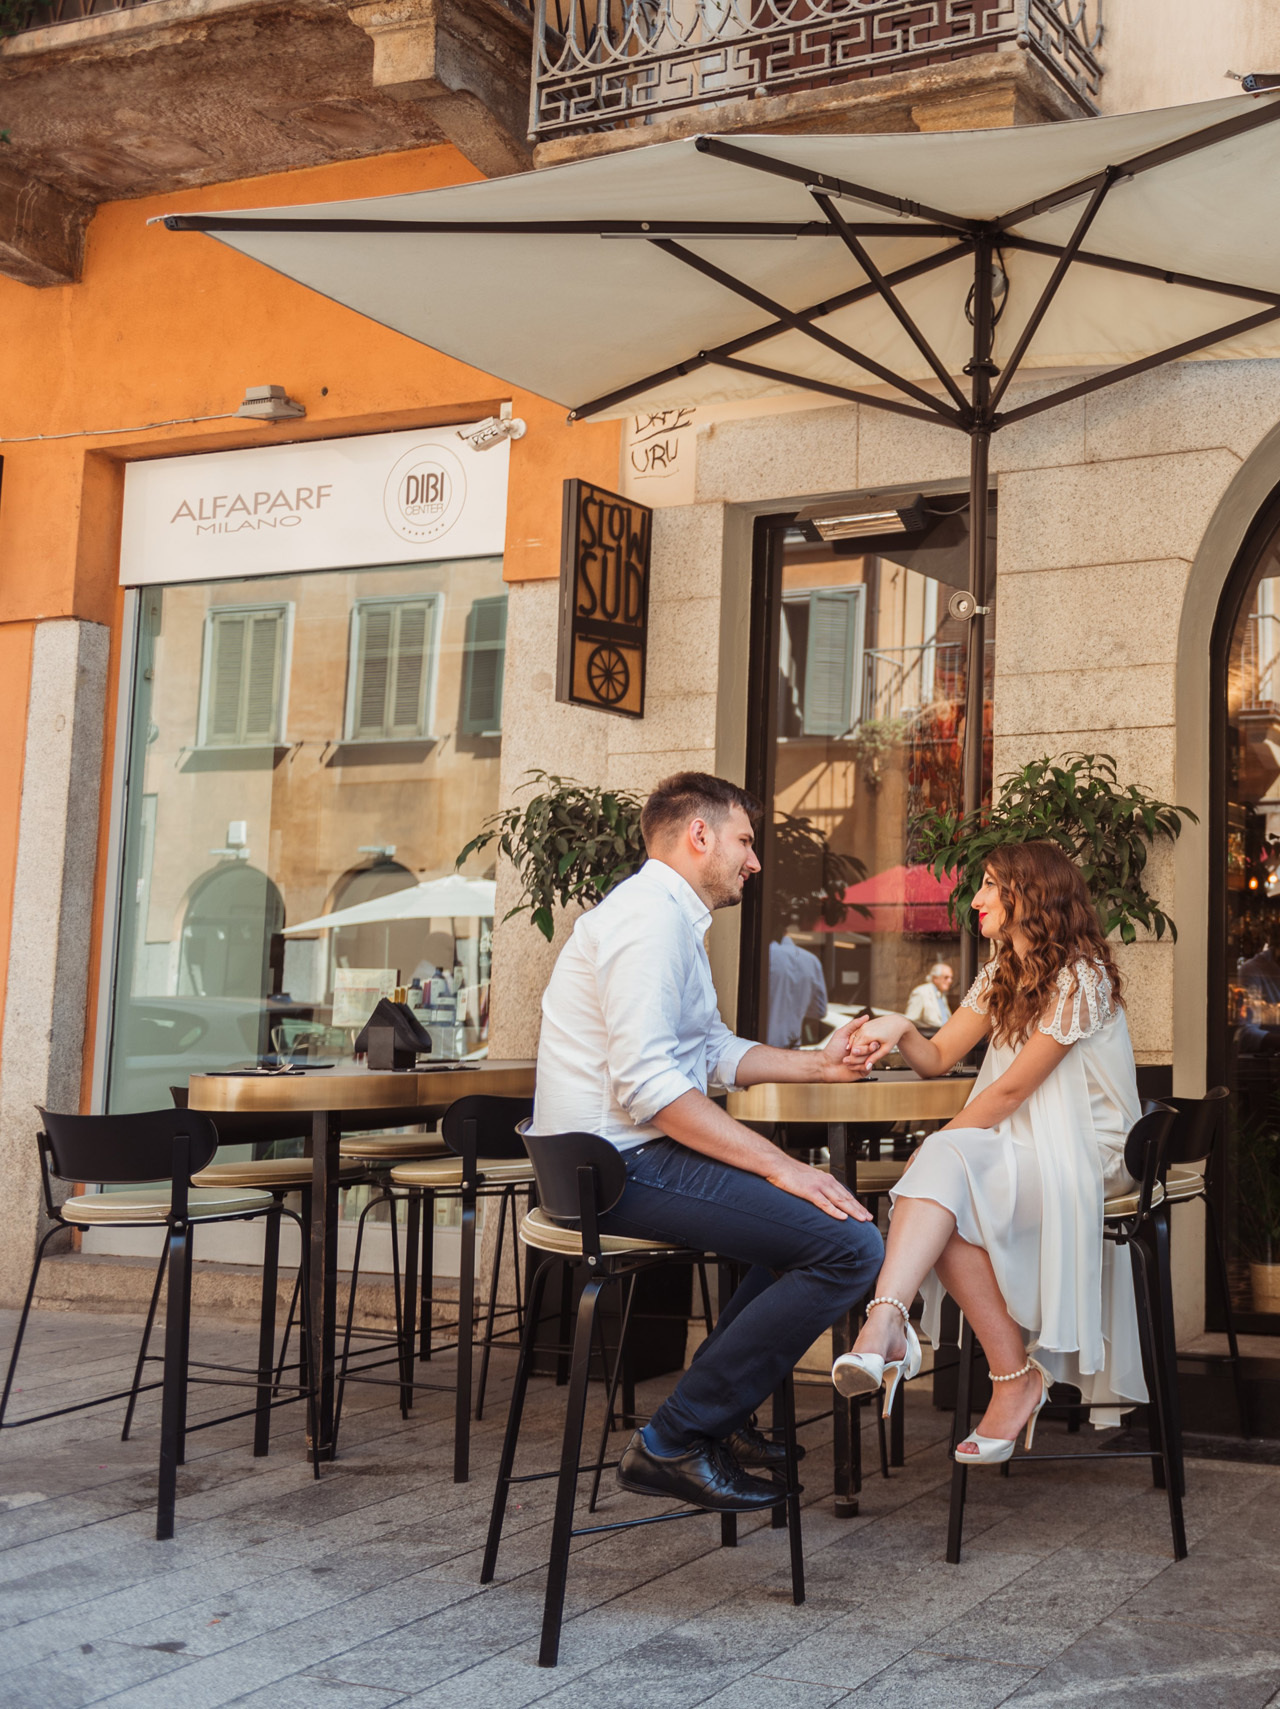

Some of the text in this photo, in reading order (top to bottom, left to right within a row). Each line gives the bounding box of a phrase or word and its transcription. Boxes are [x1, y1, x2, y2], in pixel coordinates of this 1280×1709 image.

[170, 484, 333, 523] ALFAPARF
[405, 472, 445, 505] DIBI
[196, 514, 302, 535] MILANO
[404, 503, 444, 516] CENTER
[581, 496, 647, 565] SLOW
[578, 541, 644, 624] SUD
